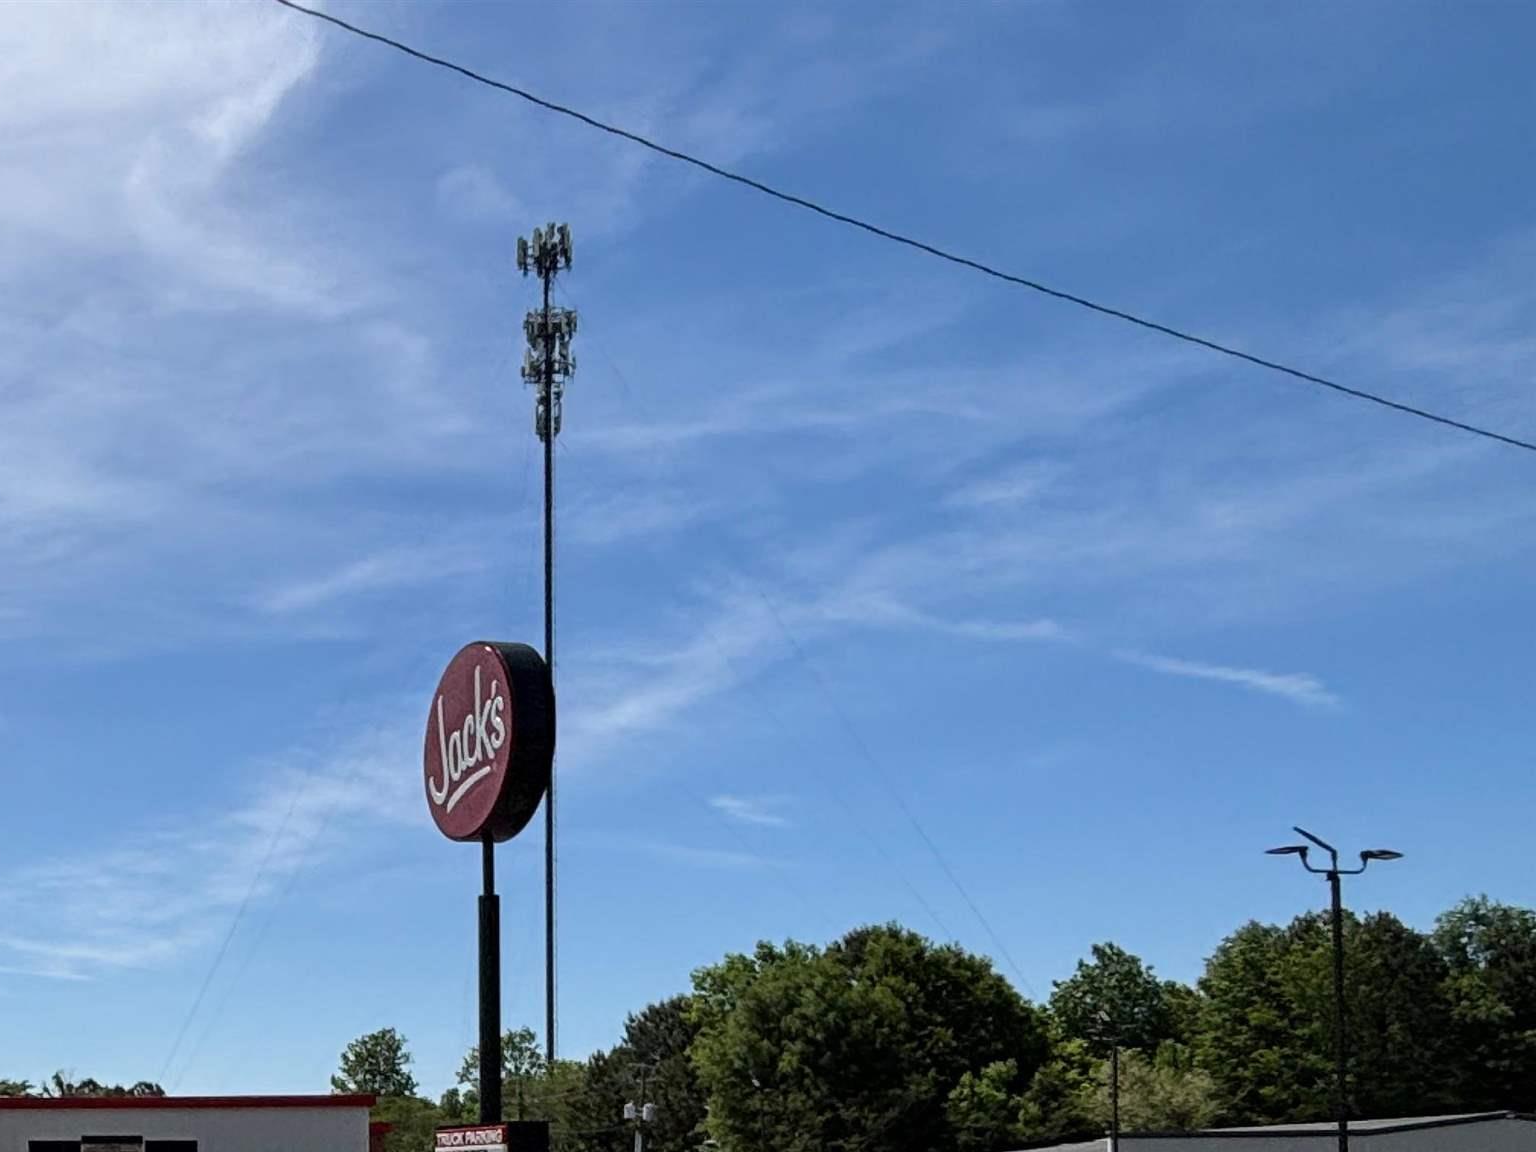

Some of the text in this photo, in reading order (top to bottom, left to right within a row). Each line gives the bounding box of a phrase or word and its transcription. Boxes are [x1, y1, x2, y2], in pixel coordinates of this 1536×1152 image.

[429, 664, 506, 806] Jack's
[436, 1128, 503, 1147] TRUCK PARKING
